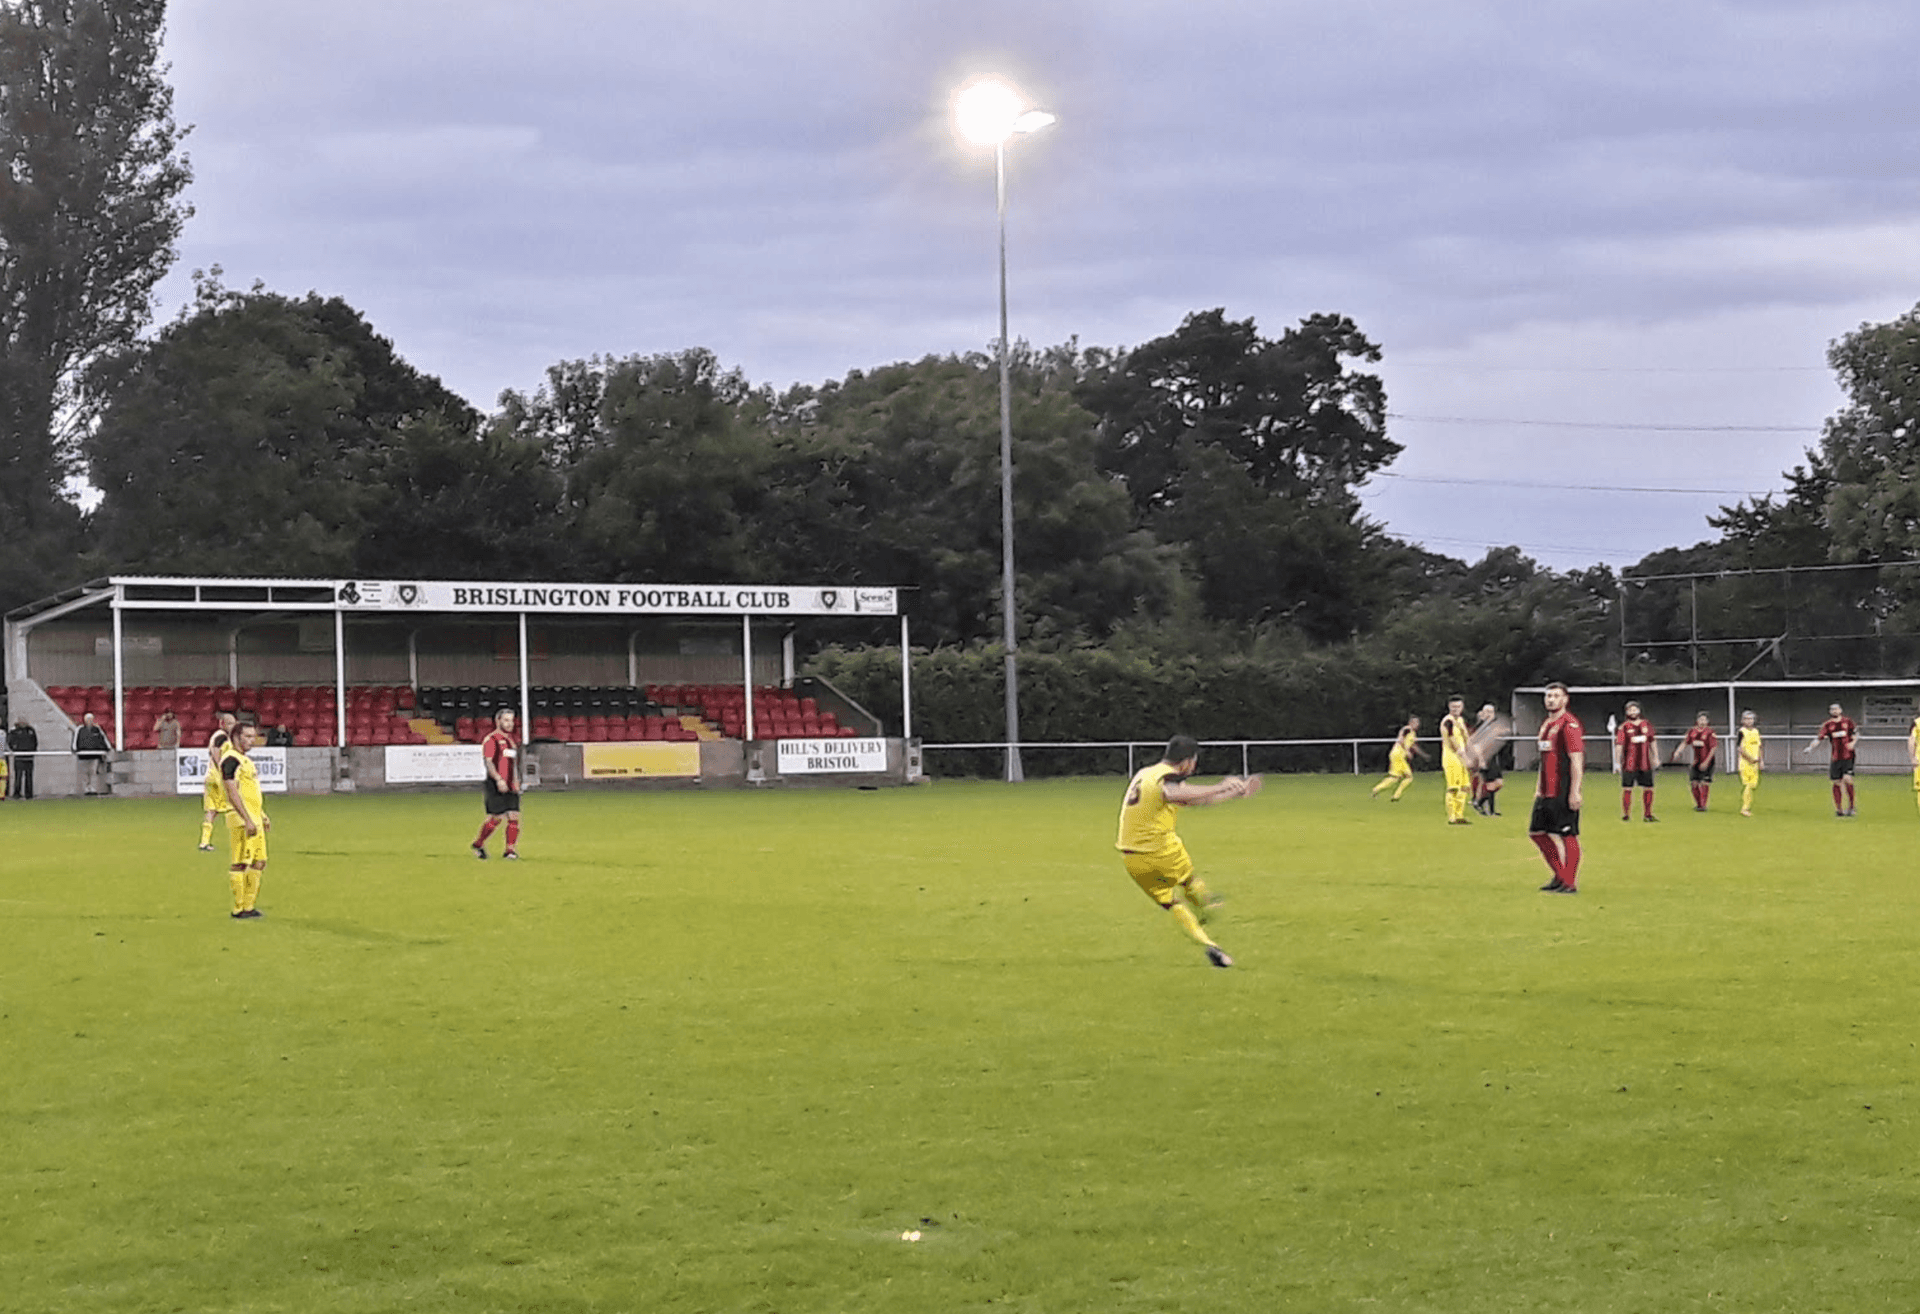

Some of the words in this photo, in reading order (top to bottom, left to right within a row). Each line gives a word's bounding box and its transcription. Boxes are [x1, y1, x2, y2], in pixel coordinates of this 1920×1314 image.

[453, 588, 610, 606] BRISLINGTON
[617, 590, 731, 607] FOOTBALL
[736, 591, 790, 608] CLUB
[780, 742, 819, 755] HILL'S
[824, 741, 882, 754] DELIVERY
[807, 756, 859, 769] BRISTOL
